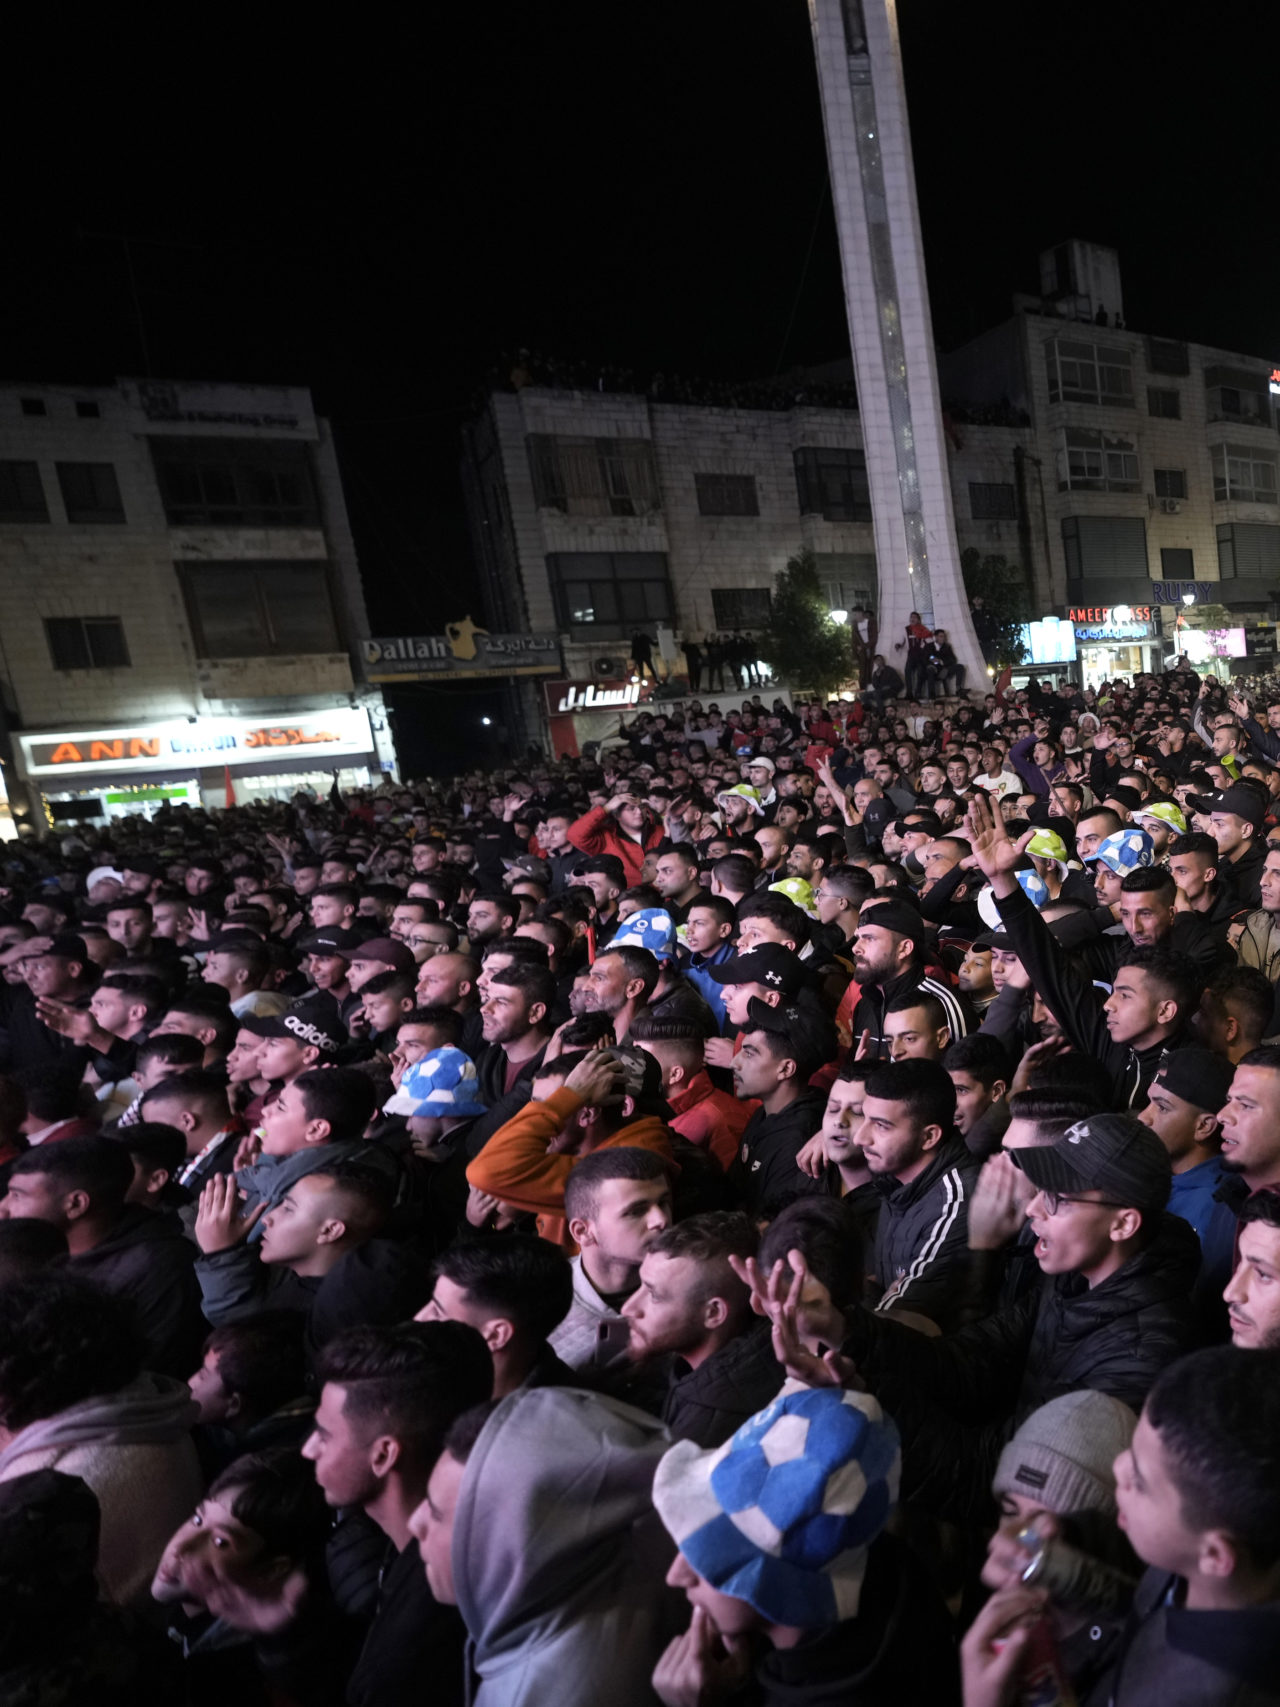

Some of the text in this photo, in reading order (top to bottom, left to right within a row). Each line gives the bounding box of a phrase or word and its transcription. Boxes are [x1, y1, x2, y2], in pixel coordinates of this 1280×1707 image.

[1152, 582, 1213, 603] RUBY
[1068, 606, 1108, 623] AMEER
[362, 637, 447, 664] Dallah
[50, 737, 161, 764] ANN
[284, 1015, 338, 1052] adidas
